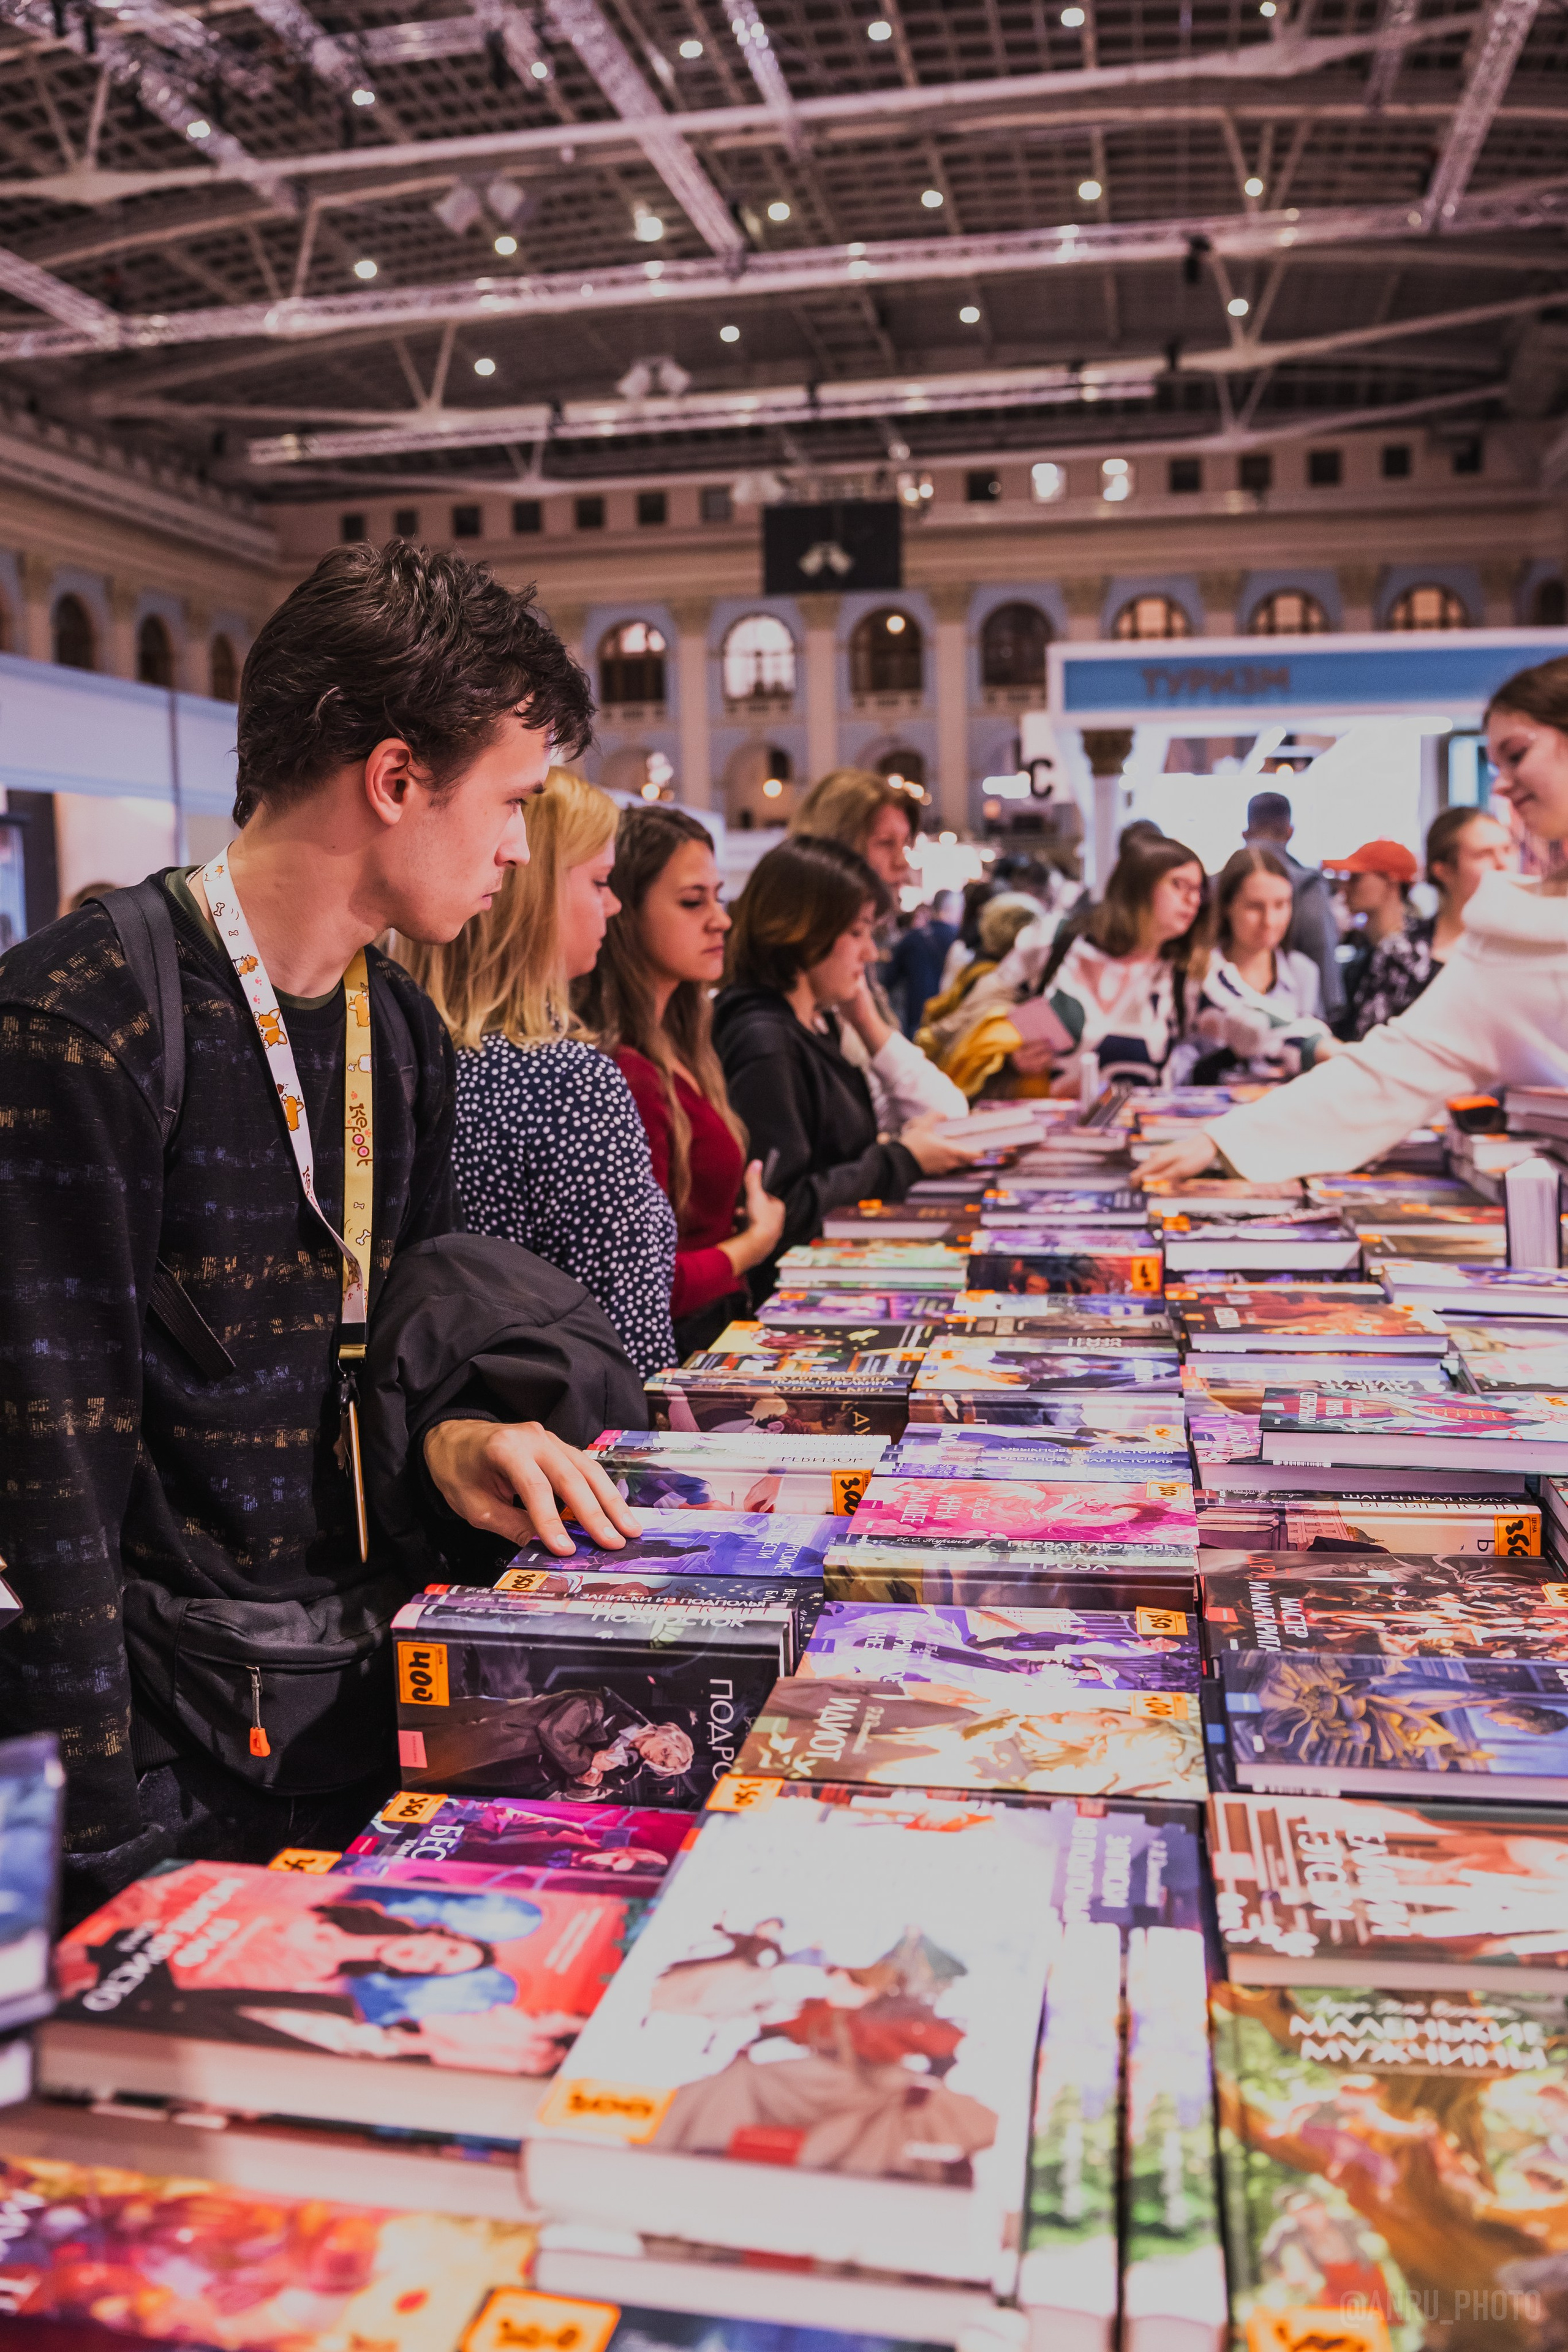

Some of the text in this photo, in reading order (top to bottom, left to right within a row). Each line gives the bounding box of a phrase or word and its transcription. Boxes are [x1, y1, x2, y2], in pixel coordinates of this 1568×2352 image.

[1140, 666, 1291, 697] ТУРИЗМ
[899, 1490, 935, 1523] НА ШЕЕ
[932, 1495, 963, 1520] АННА
[1007, 1540, 1177, 1551] ПЕРВАЯ ЛЮБОВЬ
[1505, 1520, 1531, 1556] 350
[579, 1594, 652, 1603] ЗАПИСКИ
[679, 1597, 767, 1607] ПОДПОЛЬЯ
[780, 1588, 797, 1602] ВЕЧ
[590, 1613, 745, 1628] ПОДРОСТОК
[1248, 1581, 1281, 1652] И МАРГАРИТА
[1278, 1597, 1309, 1638] МАСТЕР
[409, 1652, 434, 1702] 400
[706, 1678, 734, 1781] ПОДРО
[805, 1697, 861, 1762] ИДИОТ
[410, 1825, 466, 1862] БЕС
[1289, 2015, 1545, 2048] МАЛЕНЬКИЕ
[1300, 2038, 1548, 2070] МУЖЧИНЫ
